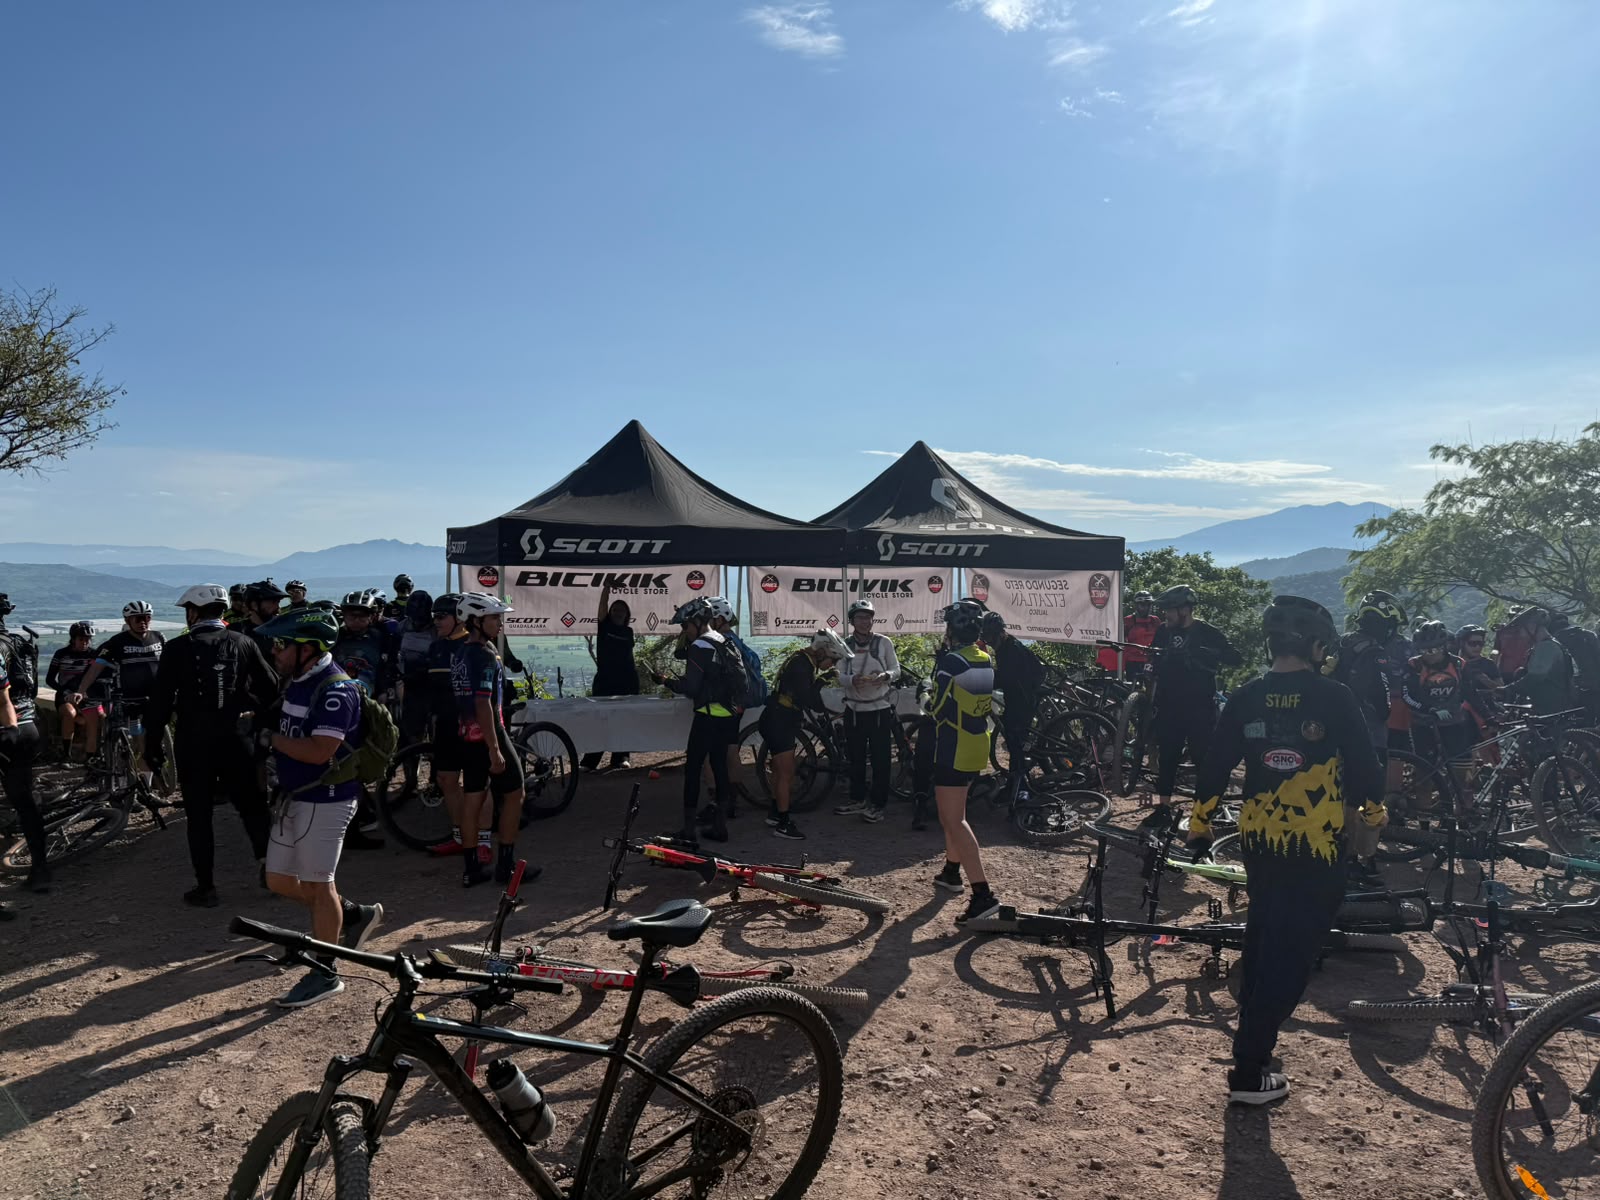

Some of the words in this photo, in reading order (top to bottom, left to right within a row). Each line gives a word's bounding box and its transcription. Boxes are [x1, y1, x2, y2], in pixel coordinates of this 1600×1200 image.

[918, 521, 1038, 534] SCOTT
[548, 538, 672, 554] SCOTT
[897, 542, 990, 557] SCOTT
[792, 578, 914, 593] BICIVIK
[1265, 693, 1301, 708] STAFF
